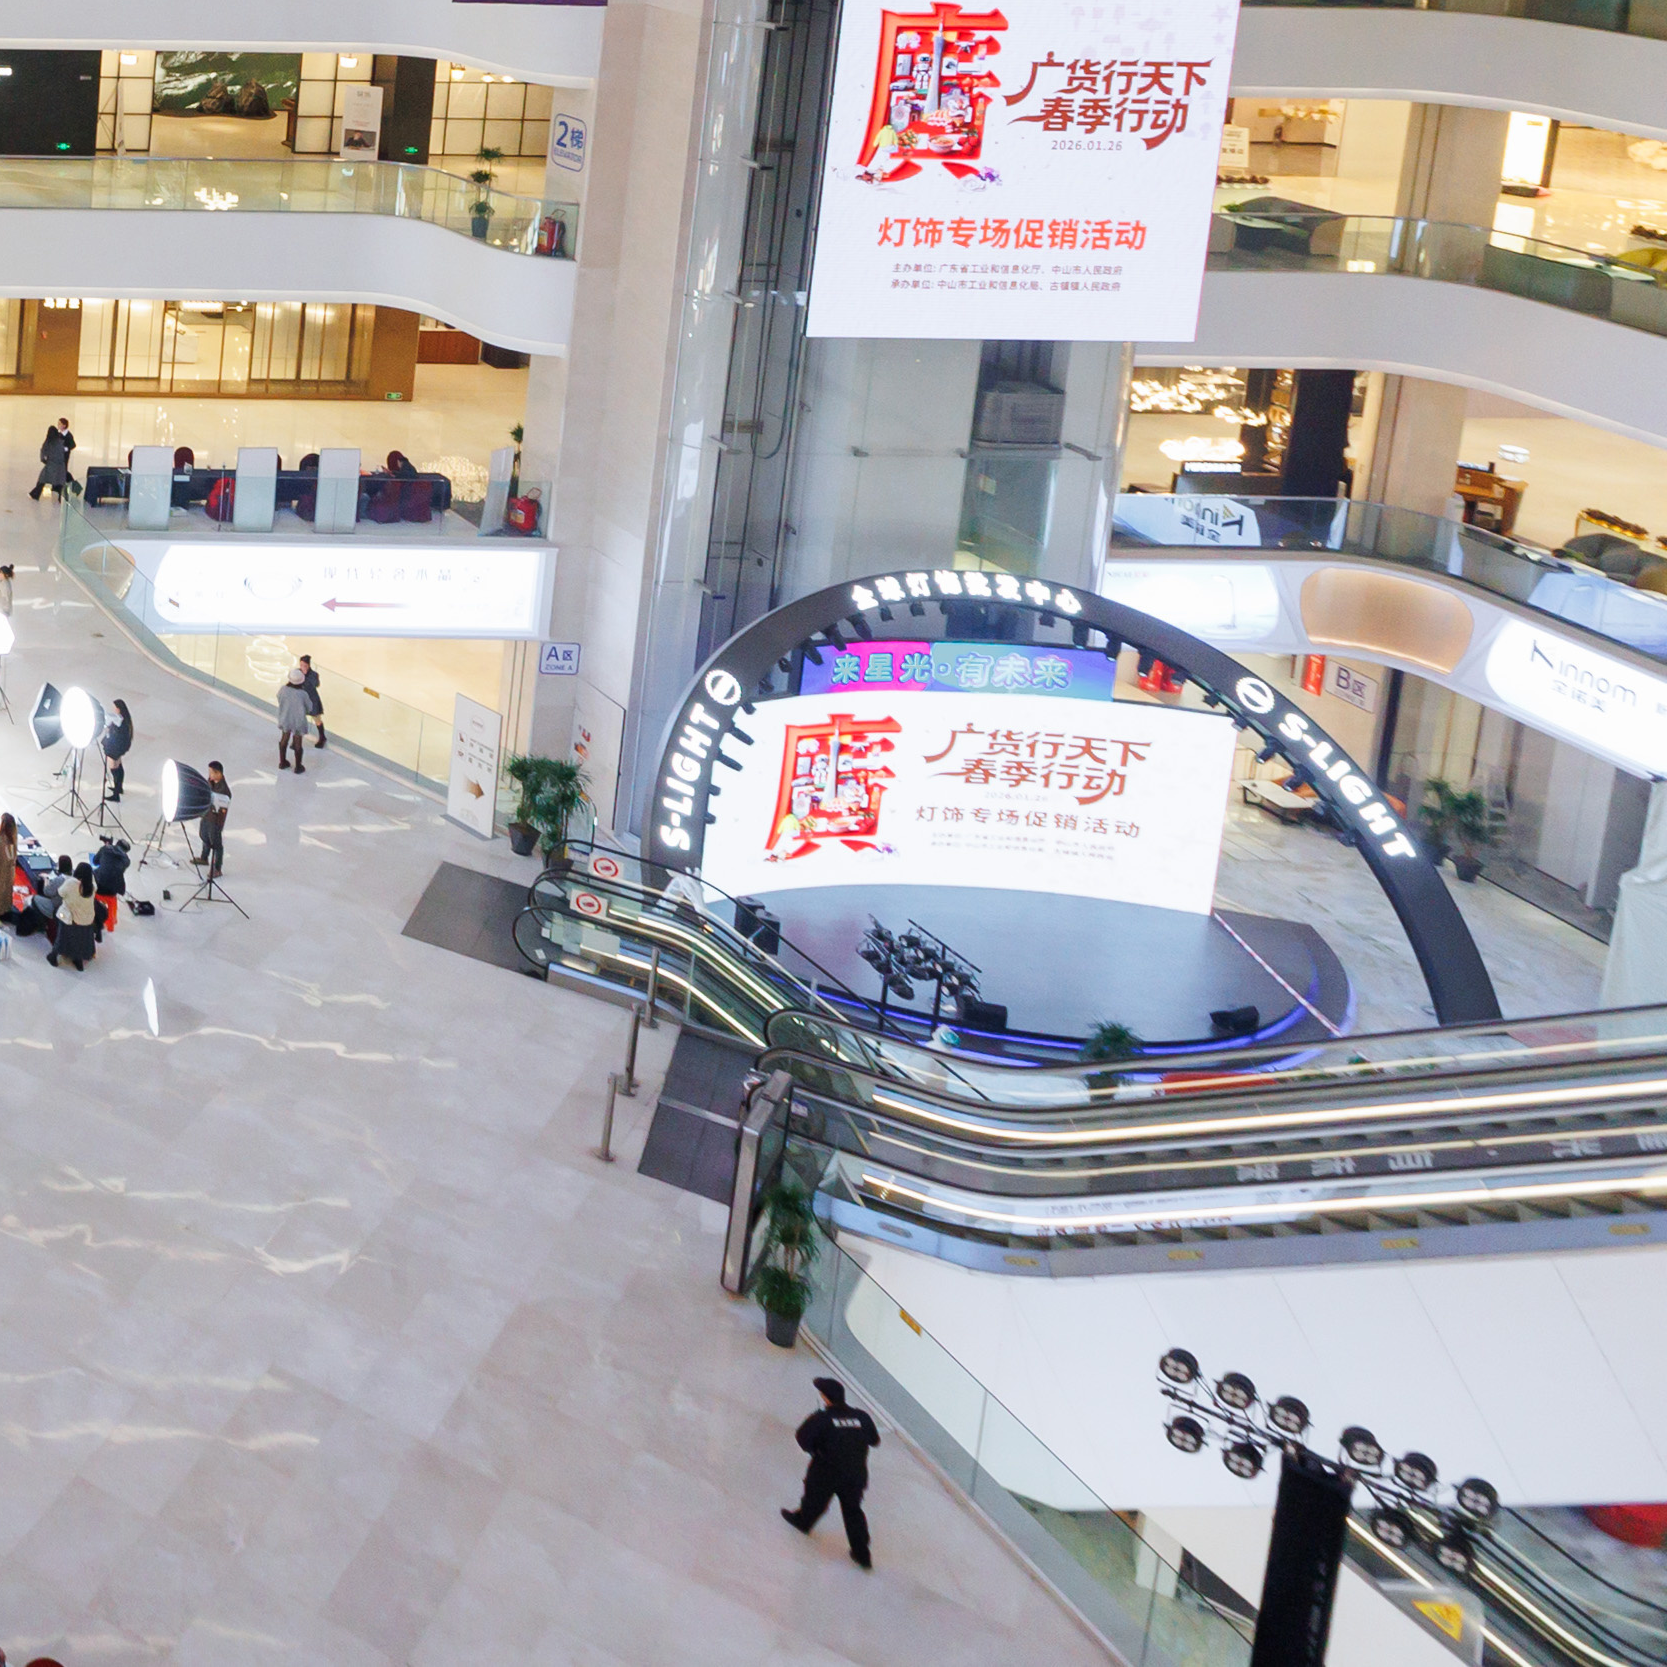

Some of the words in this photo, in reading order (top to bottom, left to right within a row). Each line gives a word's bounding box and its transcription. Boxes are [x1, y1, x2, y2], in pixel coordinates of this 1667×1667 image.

[1002, 51, 1216, 106] 广货行天下
[556, 121, 584, 150] 2梯
[1006, 96, 1190, 151] 春季行动
[1051, 140, 1123, 152] 2026.01.26
[877, 216, 1148, 251] 灯饰专场促销活动
[546, 646, 574, 662] A区
[832, 652, 1073, 690] 来星光·有未来
[1336, 666, 1367, 697] B区
[923, 723, 1152, 767] 广货行天下
[660, 702, 720, 851] S-LIGHT
[930, 757, 1128, 806] 春季行动
[1279, 713, 1416, 858] S-LIGHT
[915, 804, 1141, 838] 灯饰专场促销活动
